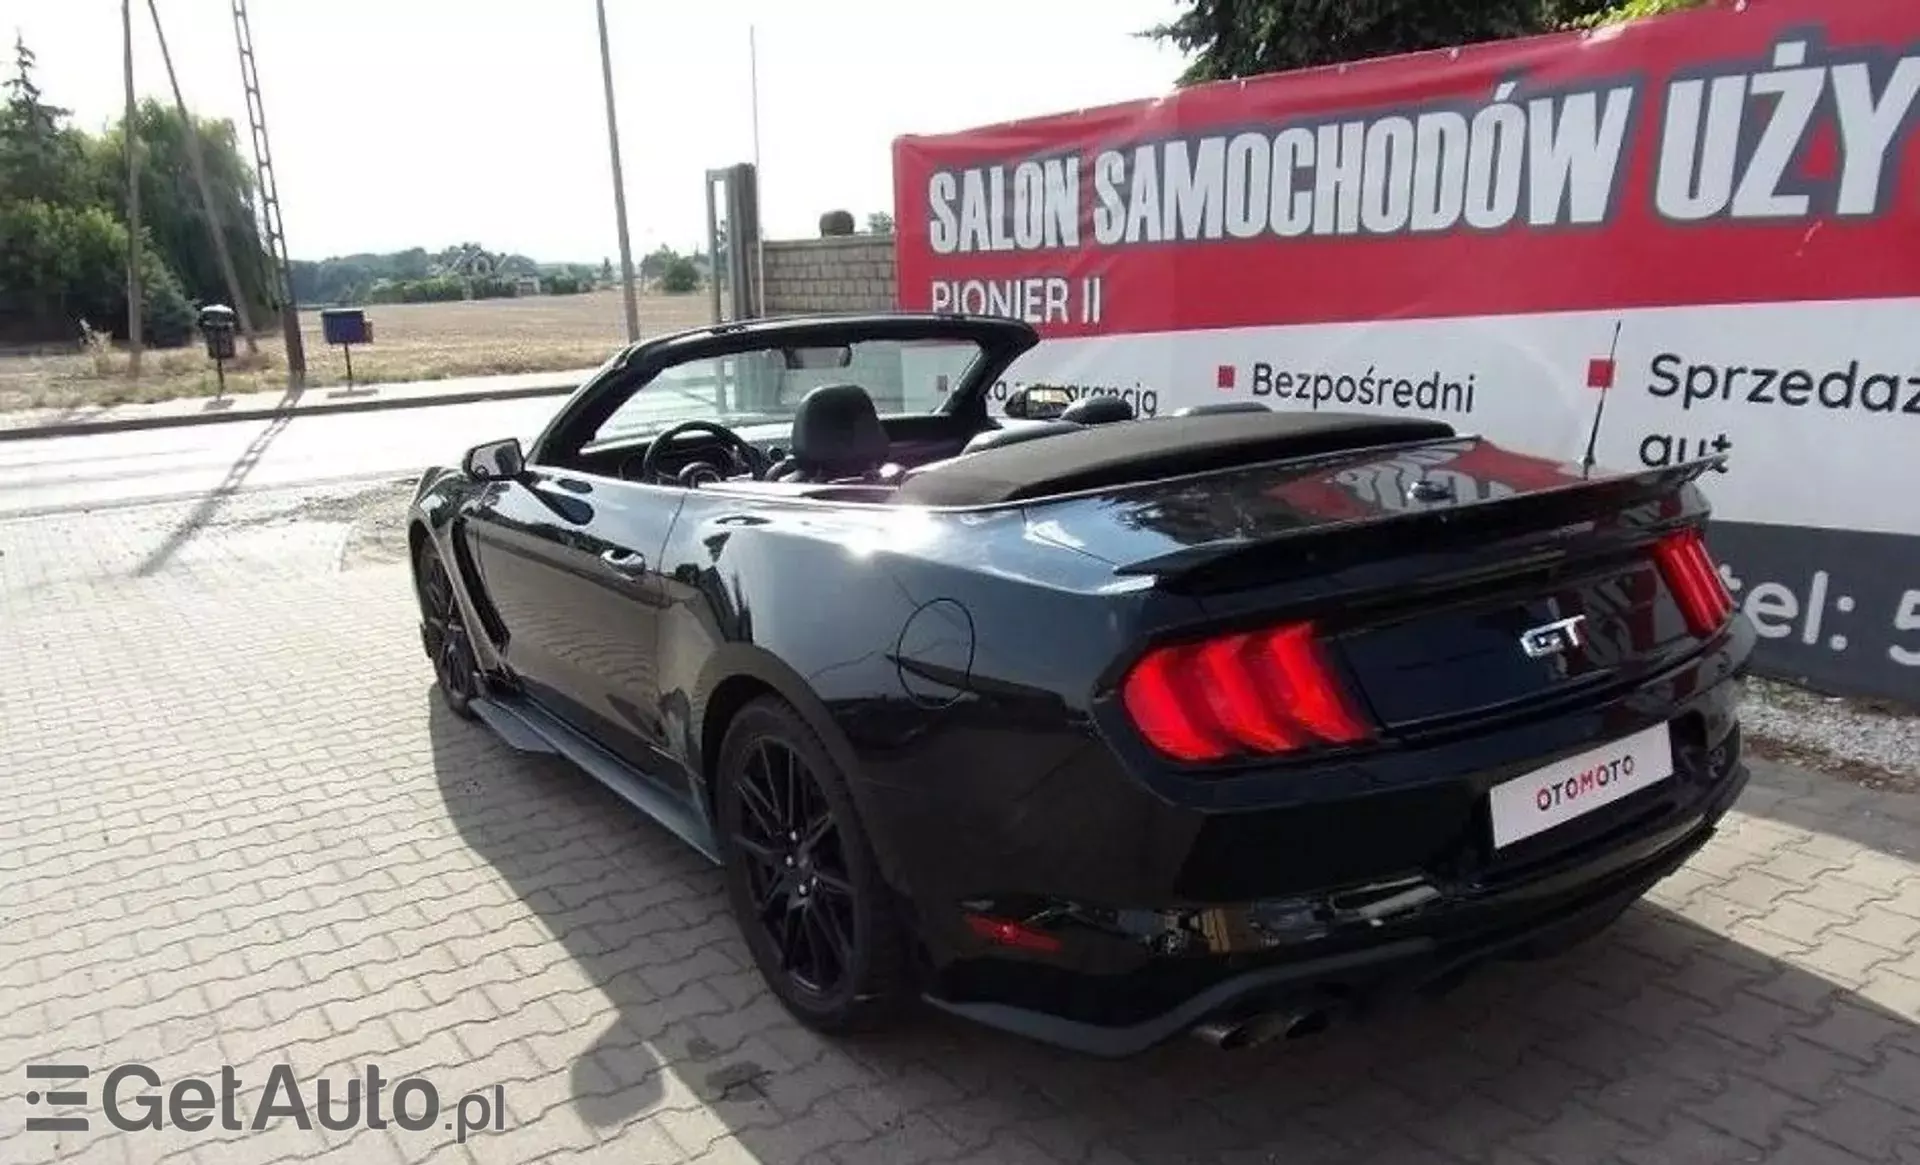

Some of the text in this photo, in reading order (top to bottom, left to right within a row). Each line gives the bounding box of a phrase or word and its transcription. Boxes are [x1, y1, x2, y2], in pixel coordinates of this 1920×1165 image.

[929, 40, 1920, 254] SALON SAMOCHODÓW UŻY
[932, 277, 1101, 325] PIONIER II
[1252, 363, 1475, 413] Bezpośredni
[1520, 614, 1586, 657] GT
[1536, 754, 1635, 811] OTOMOTO
